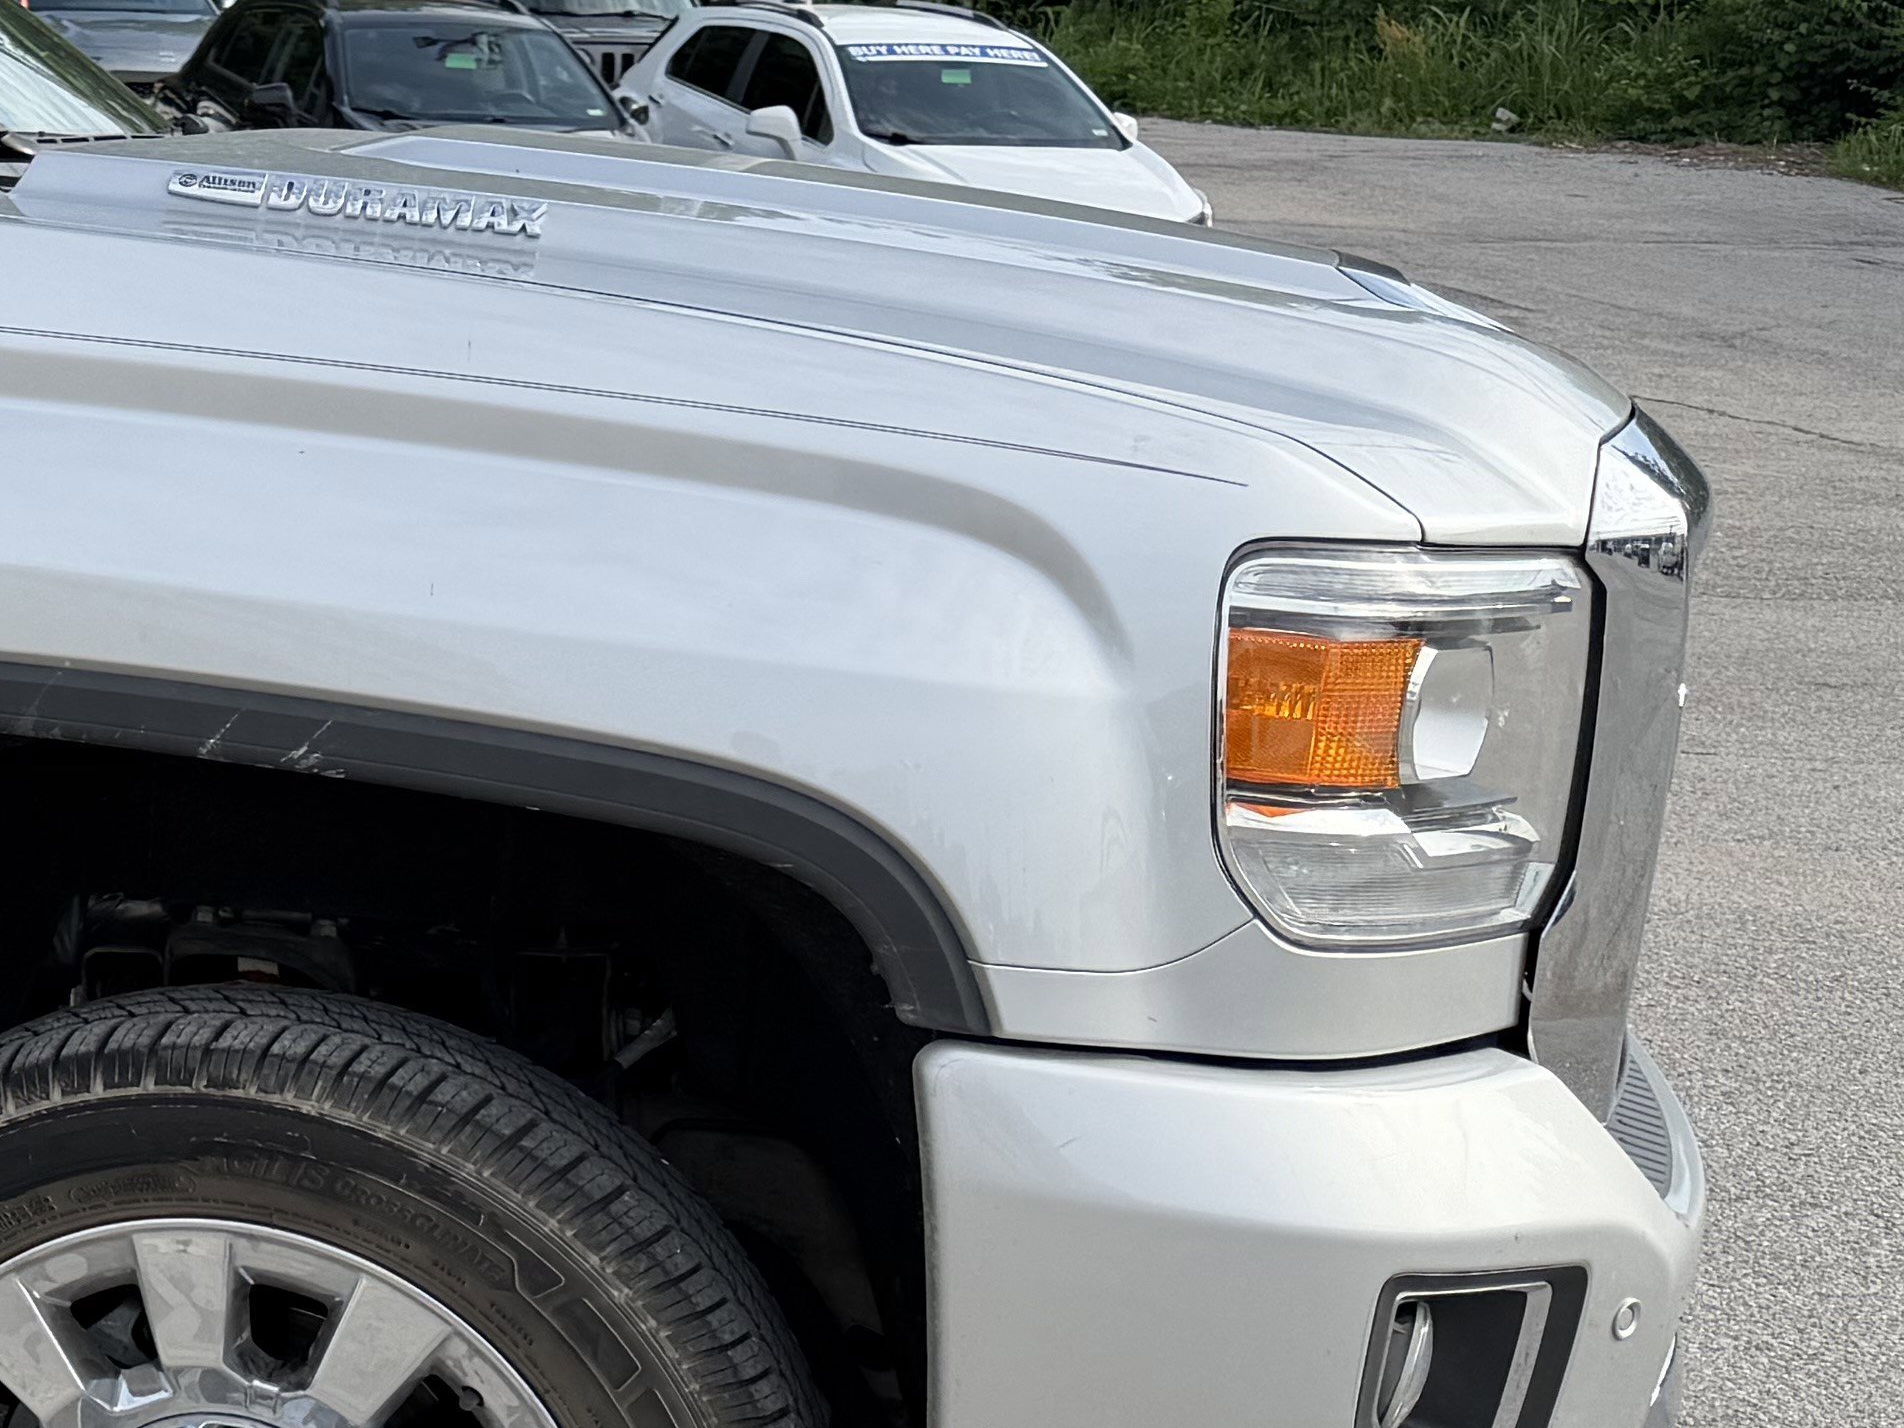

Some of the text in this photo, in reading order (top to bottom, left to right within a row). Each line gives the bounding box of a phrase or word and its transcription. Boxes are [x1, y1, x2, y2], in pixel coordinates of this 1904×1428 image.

[847, 44, 1042, 62] BUY HERE PAY HERE!
[198, 174, 258, 190] Allison
[266, 175, 548, 239] DURAMAX
